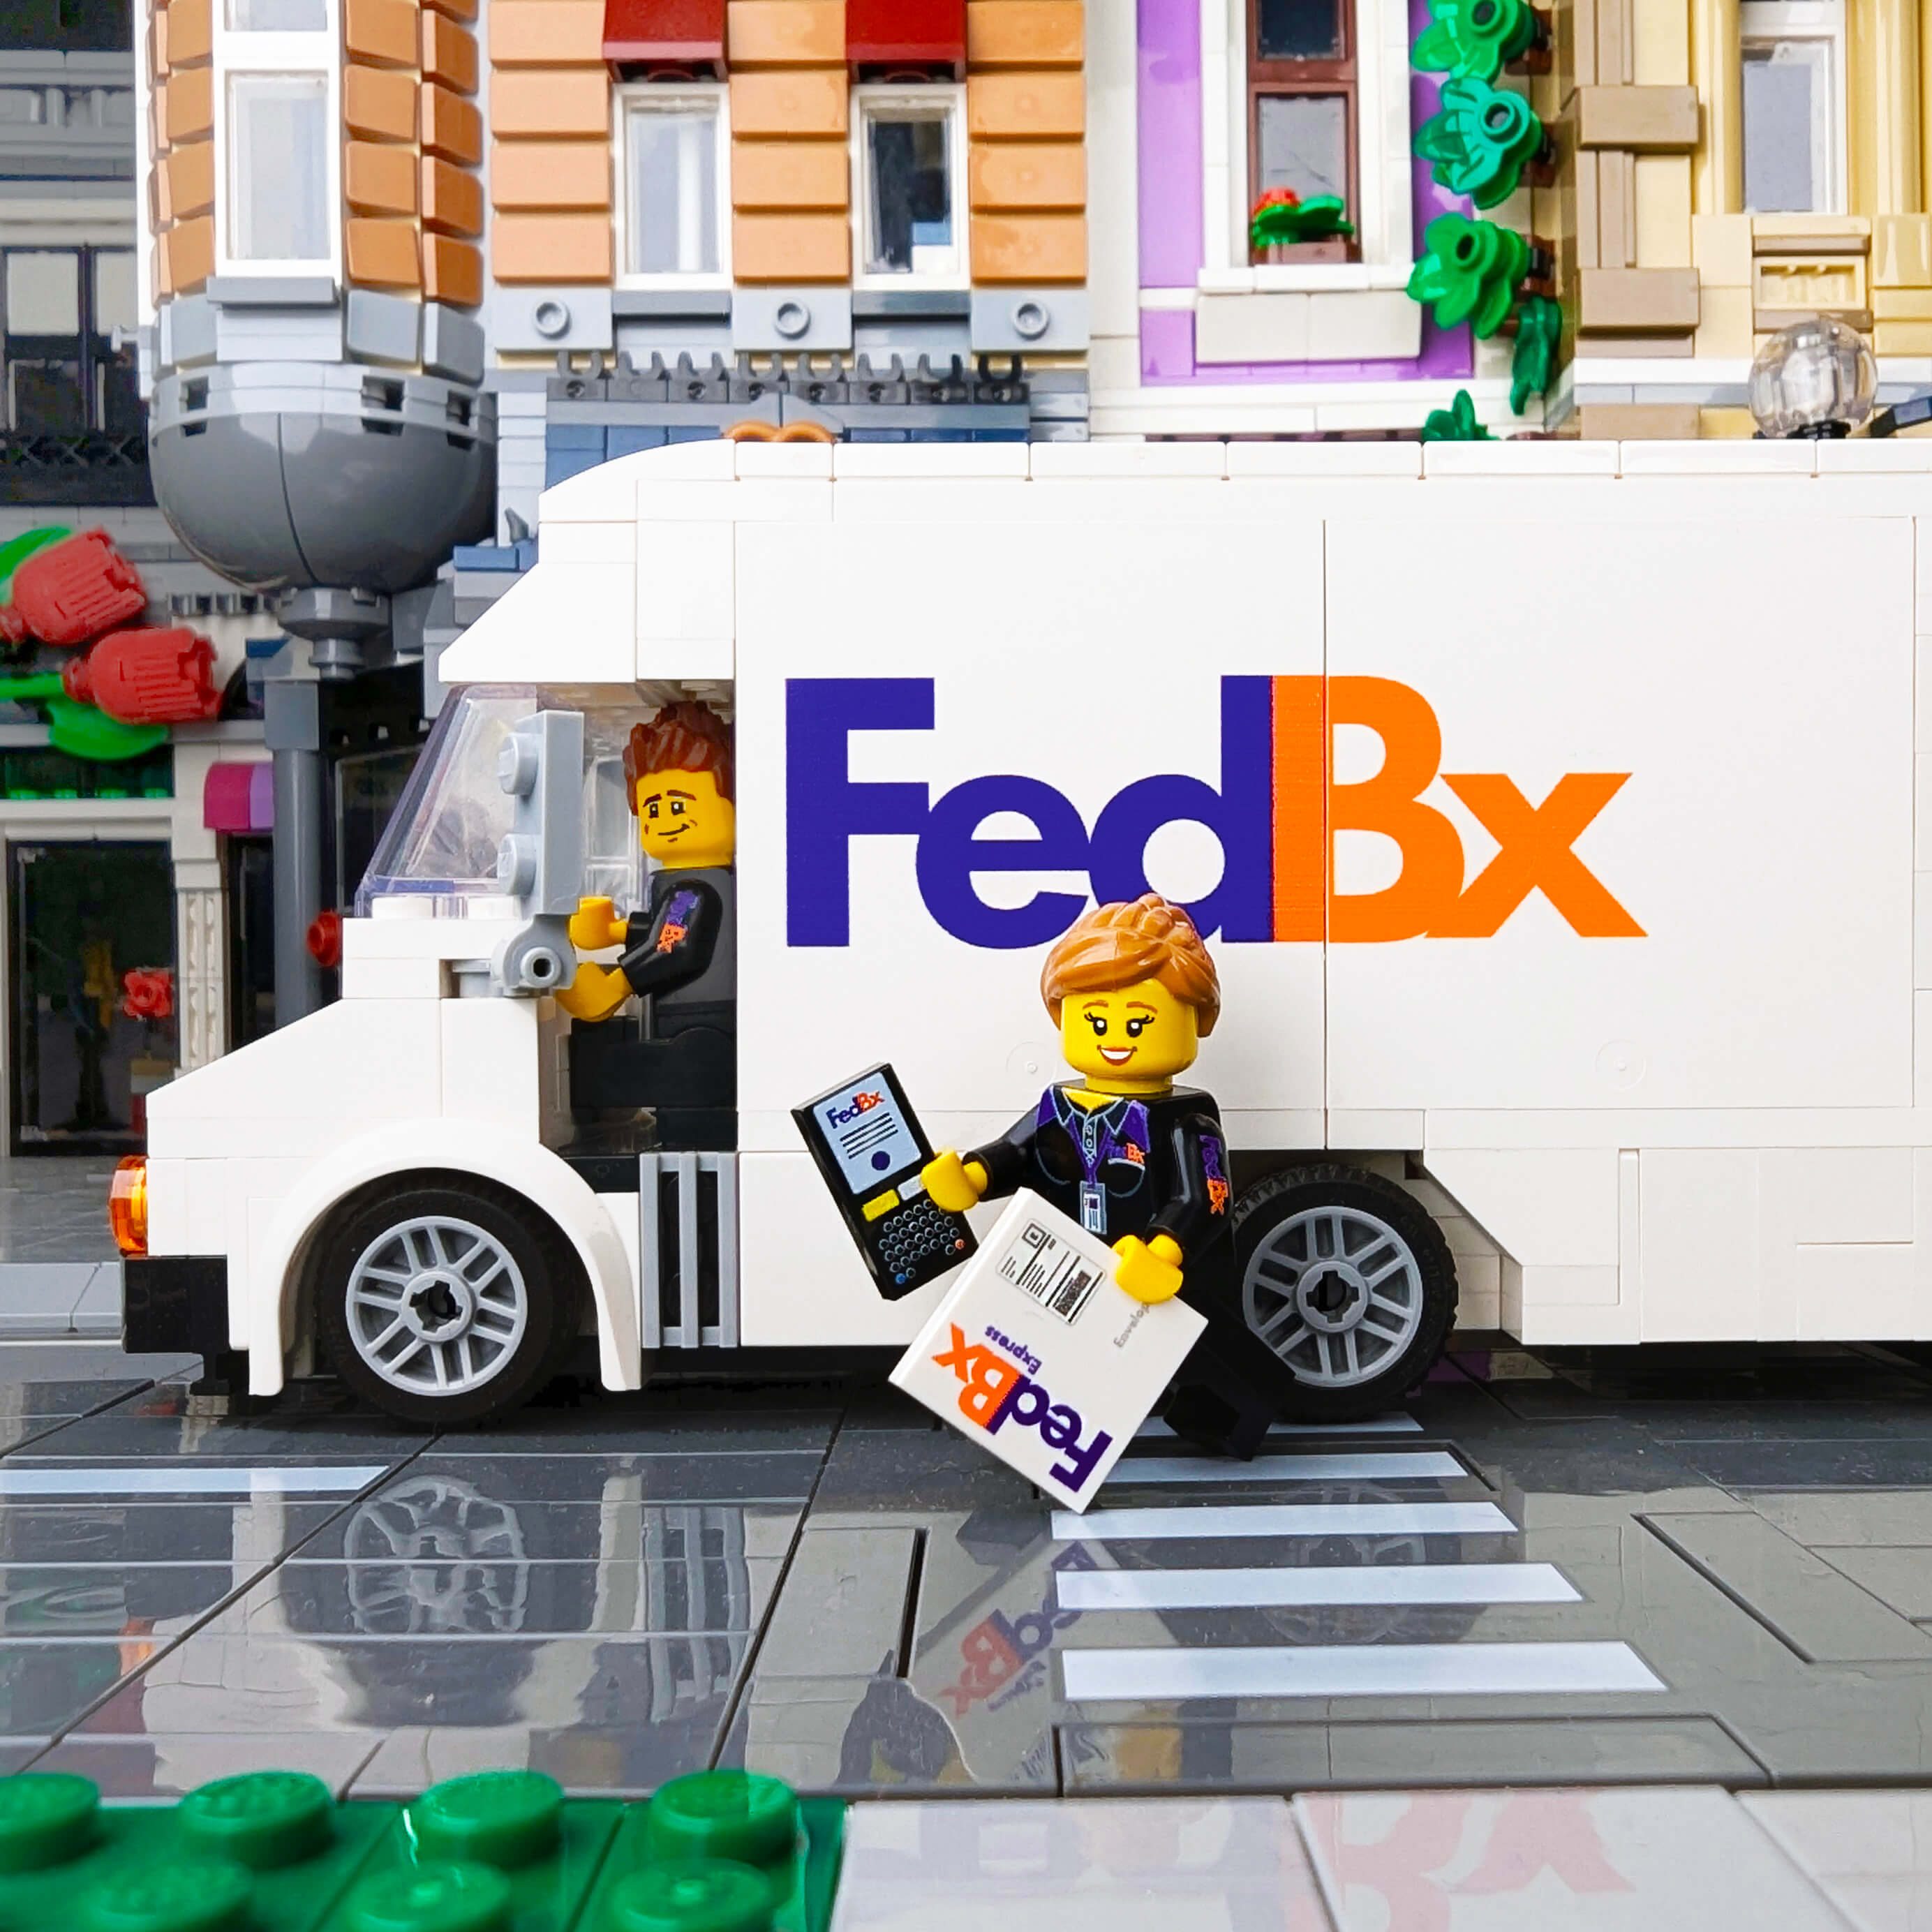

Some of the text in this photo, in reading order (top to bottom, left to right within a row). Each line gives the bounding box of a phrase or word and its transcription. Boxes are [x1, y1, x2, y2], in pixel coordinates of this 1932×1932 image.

[786, 674, 1648, 949] FedBx
[826, 1091, 885, 1129] FedBx
[985, 1325, 1042, 1375] Express
[1113, 1302, 1150, 1348] Envelop
[932, 1321, 1114, 1492] FedBx
